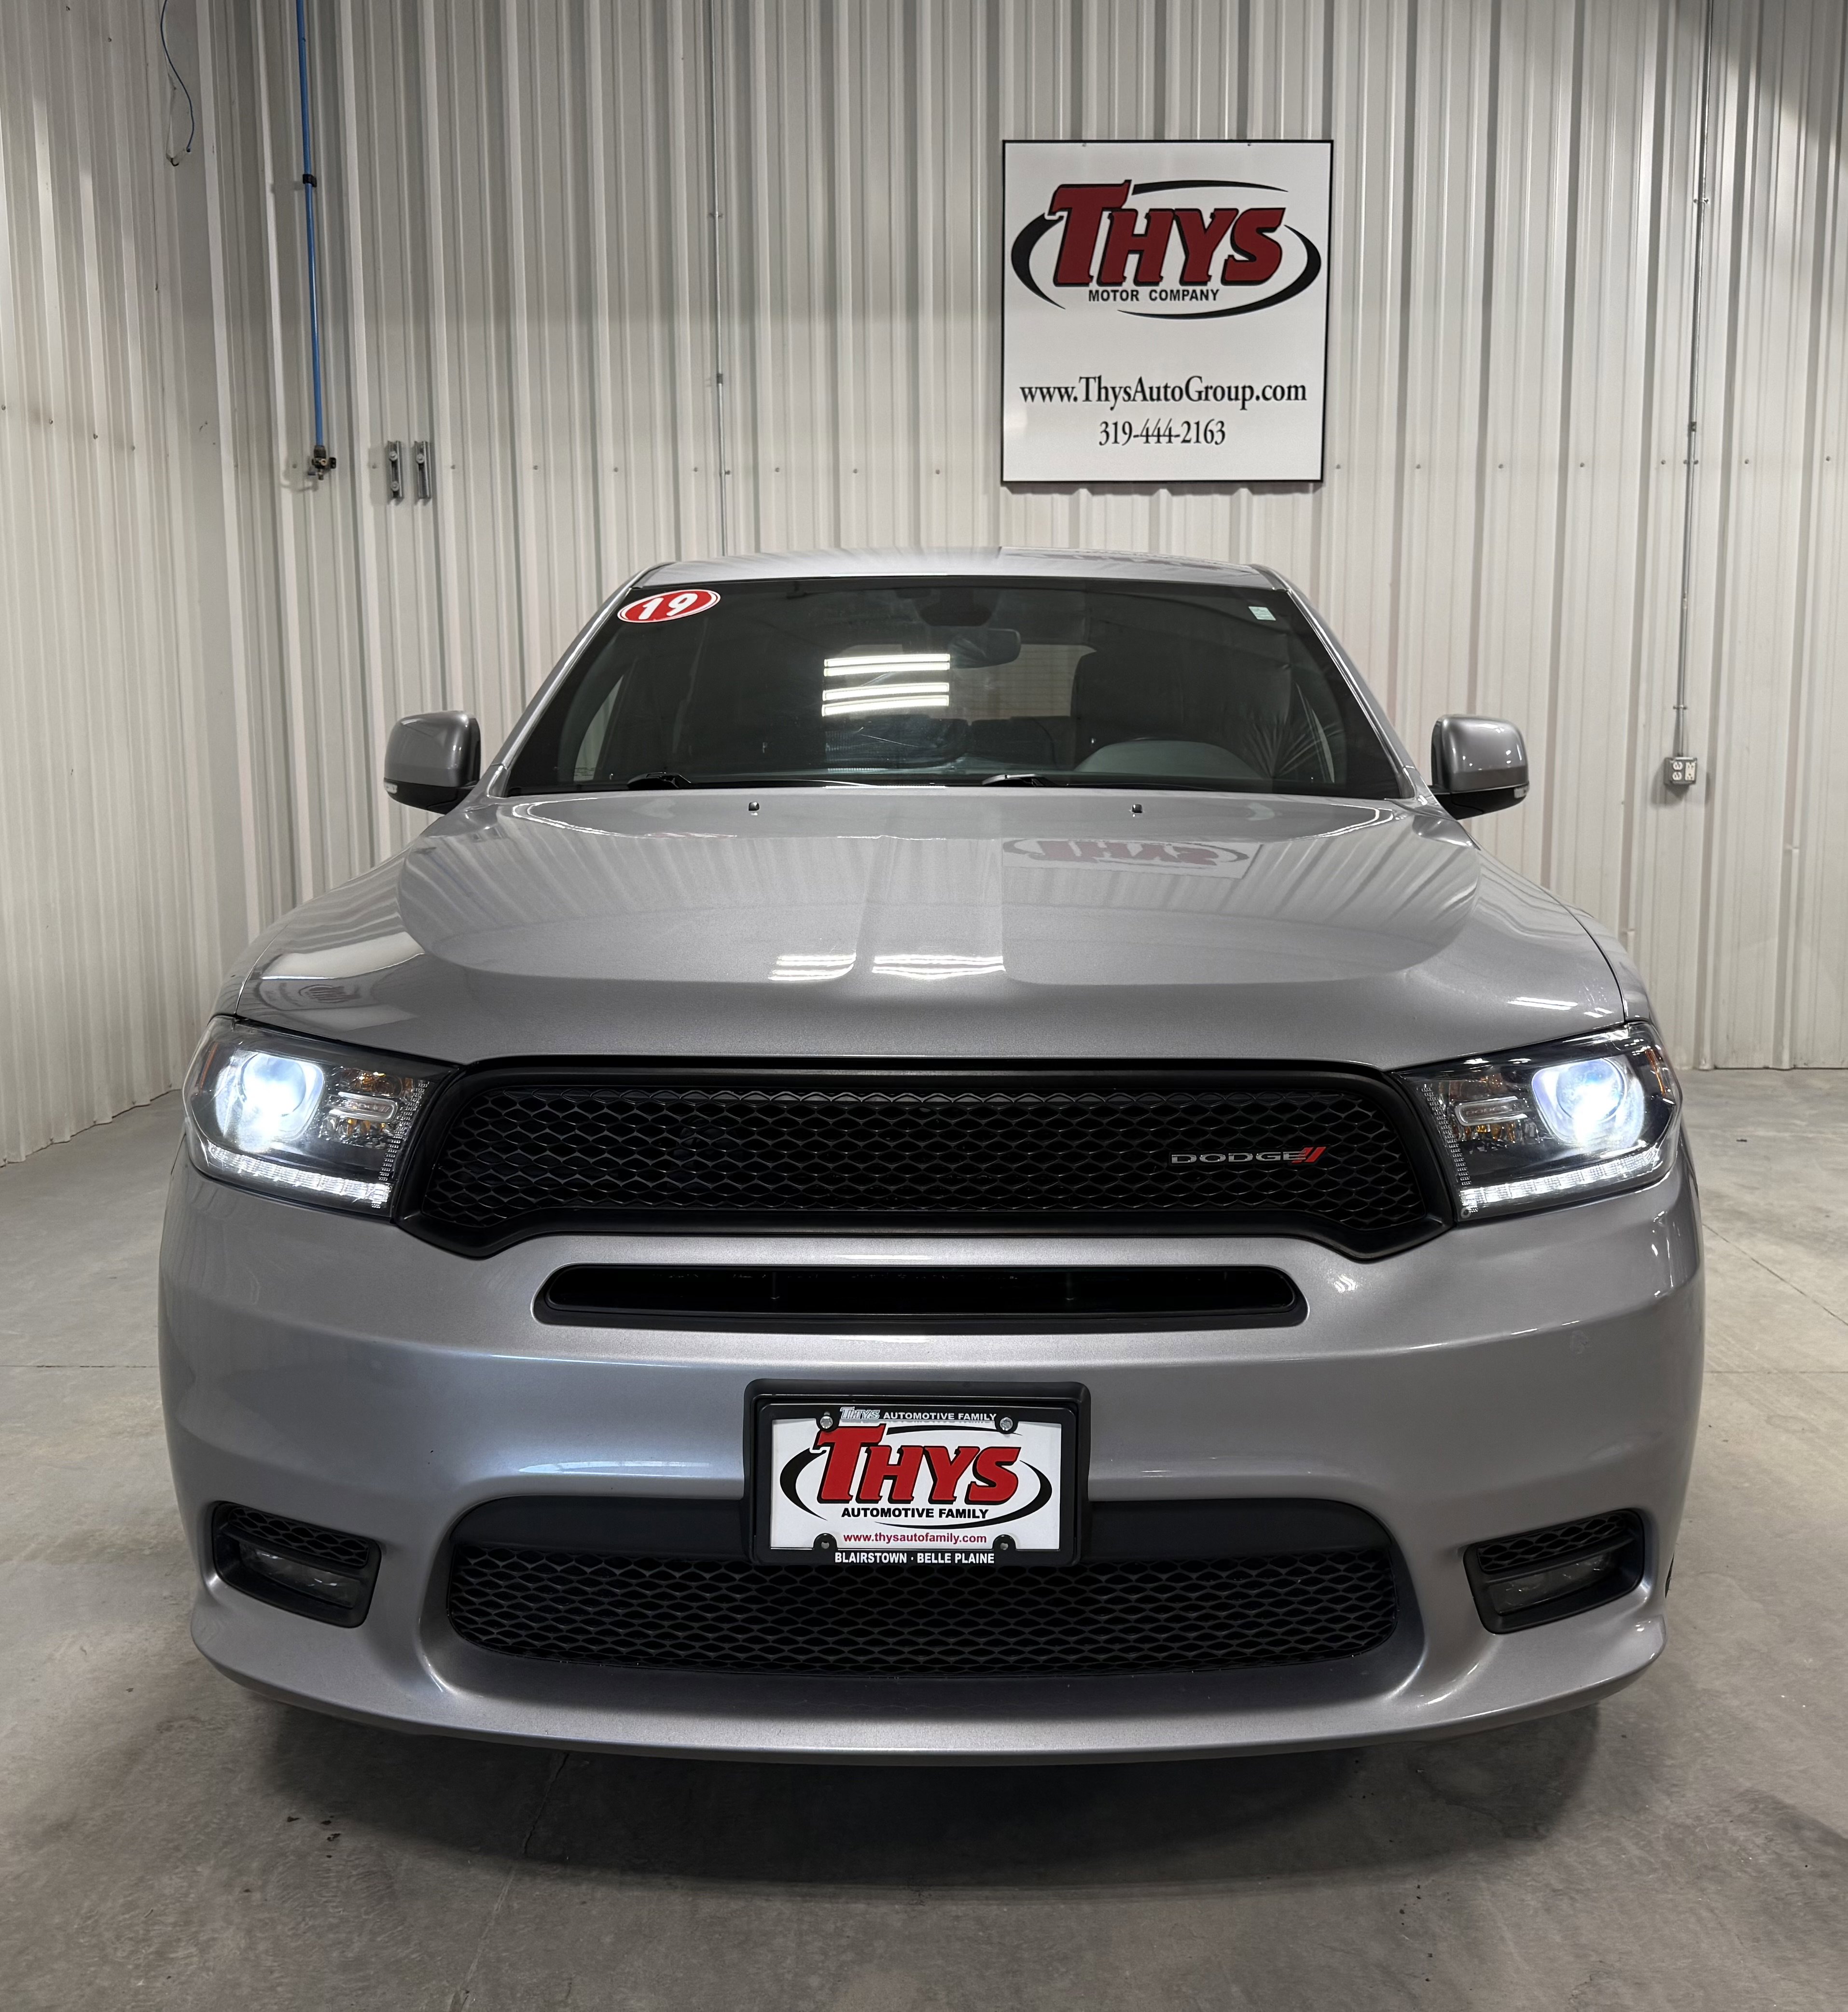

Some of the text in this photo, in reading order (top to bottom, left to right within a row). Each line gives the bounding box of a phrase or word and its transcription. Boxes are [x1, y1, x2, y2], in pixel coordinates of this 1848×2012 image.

[1049, 180, 1286, 287] THYS
[1088, 289, 1220, 302] MOTOR COMPANY
[1019, 376, 1307, 411] www.ThysAutoGroup.com
[1098, 418, 1226, 445] 319-444-2163
[638, 593, 698, 620] 19
[1171, 1152, 1306, 1164] DODGE
[840, 1406, 880, 1419] THYS
[813, 1423, 1021, 1505] THYS
[841, 1508, 989, 1519] AUTOMOTIVE FAMILY
[843, 1532, 987, 1544] www.thysautofamily.com
[834, 1552, 995, 1564] BLAIRSTOWN BELLE PLAINE
